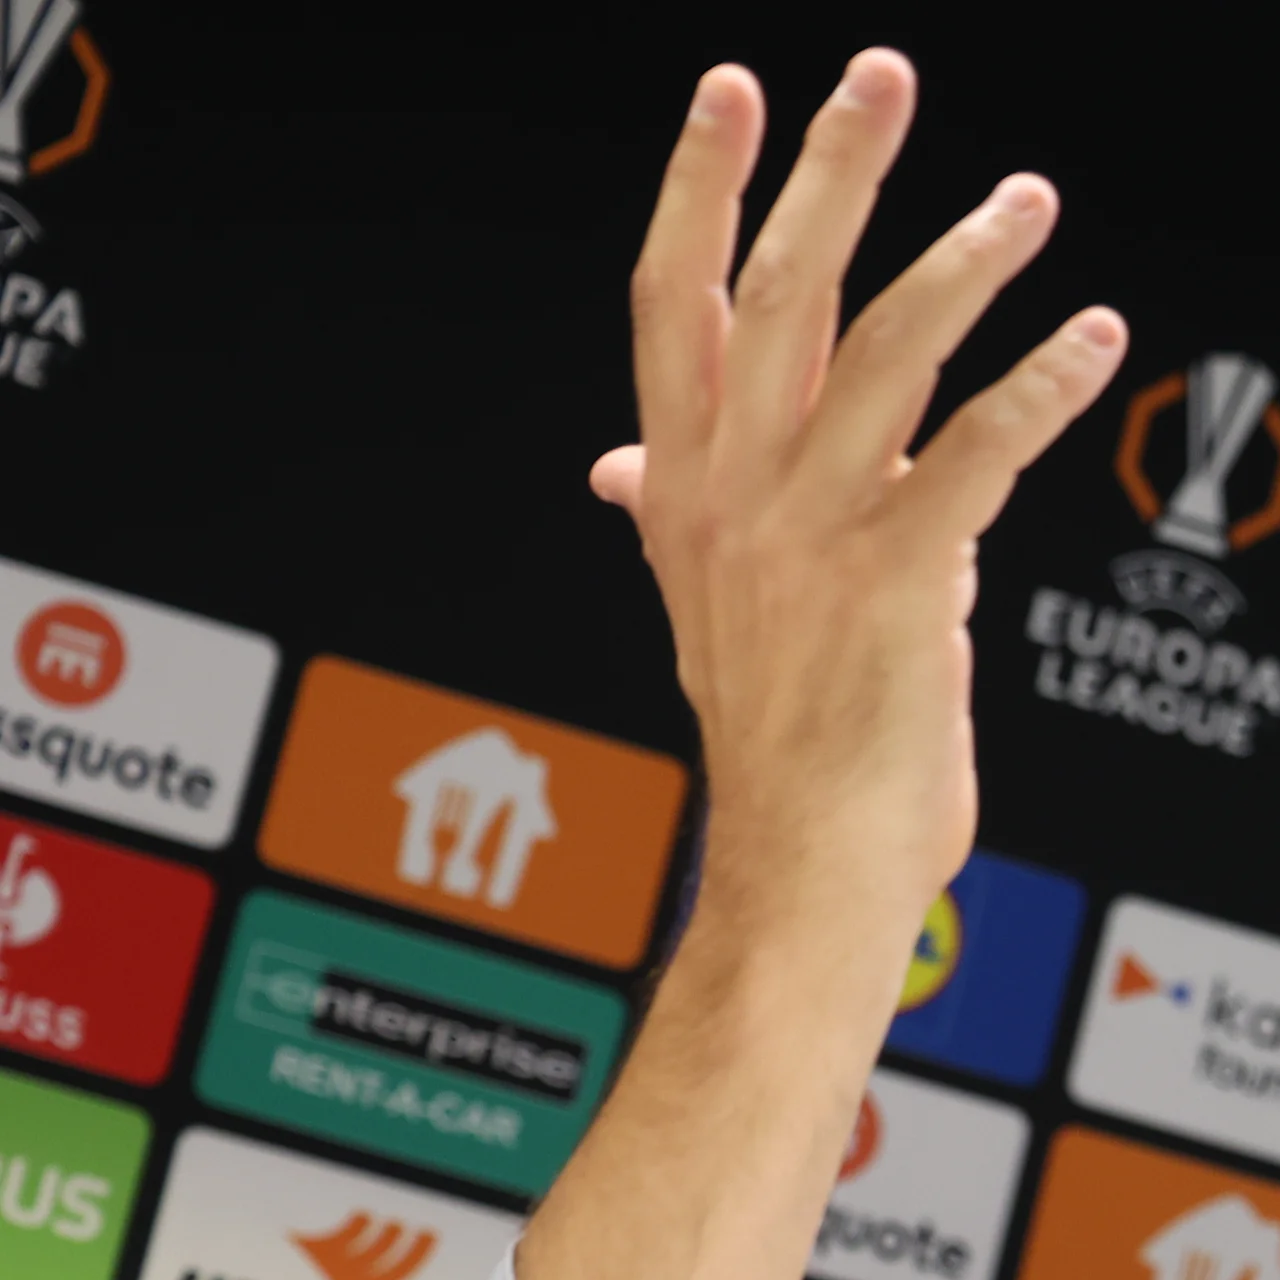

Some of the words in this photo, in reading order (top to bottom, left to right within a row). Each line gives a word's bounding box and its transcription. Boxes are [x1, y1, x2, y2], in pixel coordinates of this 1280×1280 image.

[1035, 652, 1254, 757] LEAGUE
[0, 706, 216, 812] squote
[258, 968, 584, 1090] enterprise
